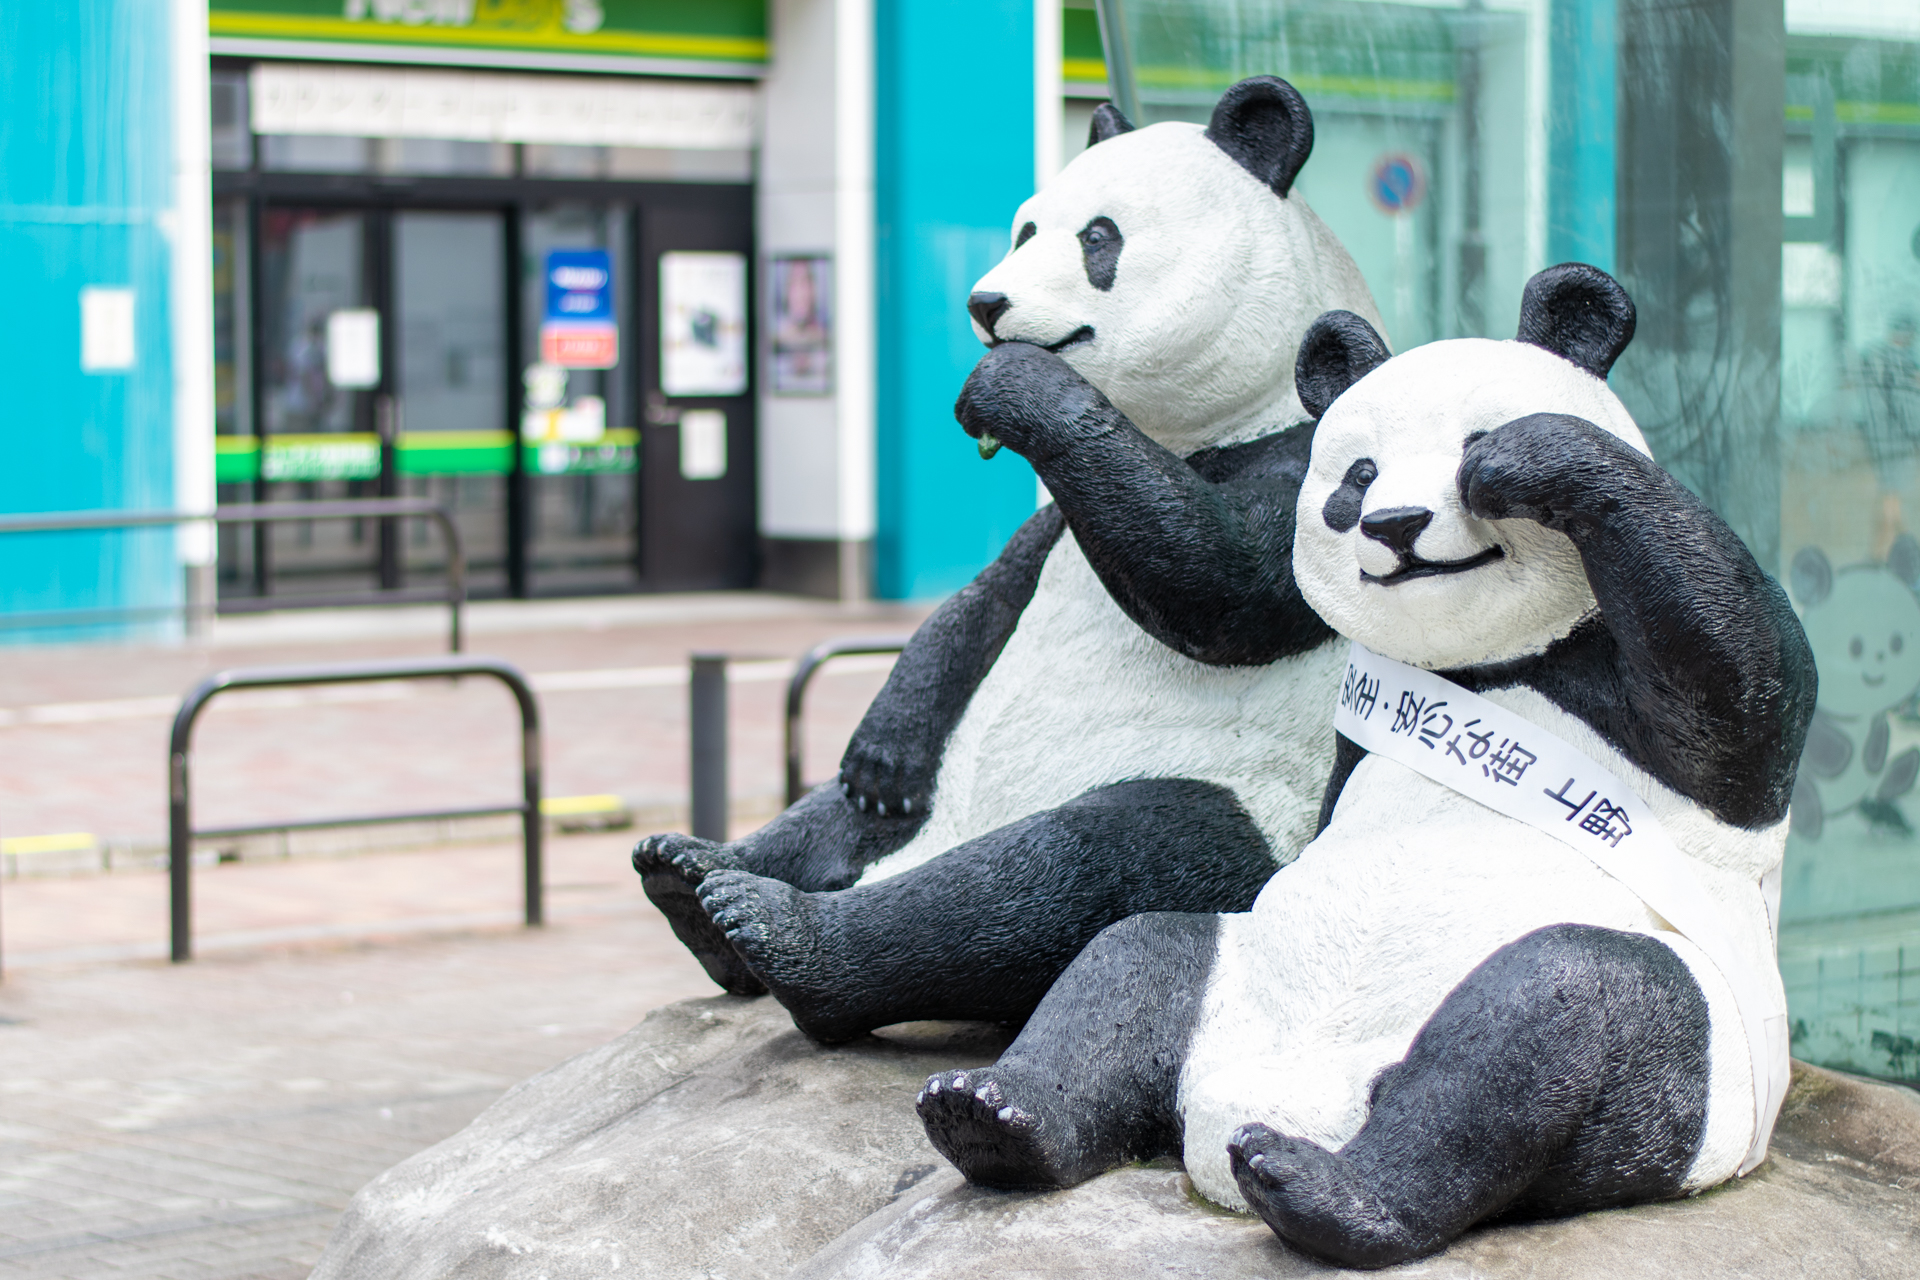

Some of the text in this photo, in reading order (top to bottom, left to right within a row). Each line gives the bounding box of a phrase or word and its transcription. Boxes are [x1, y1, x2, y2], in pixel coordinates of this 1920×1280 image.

[1341, 663, 1632, 848] 安全・安心な街 上野
